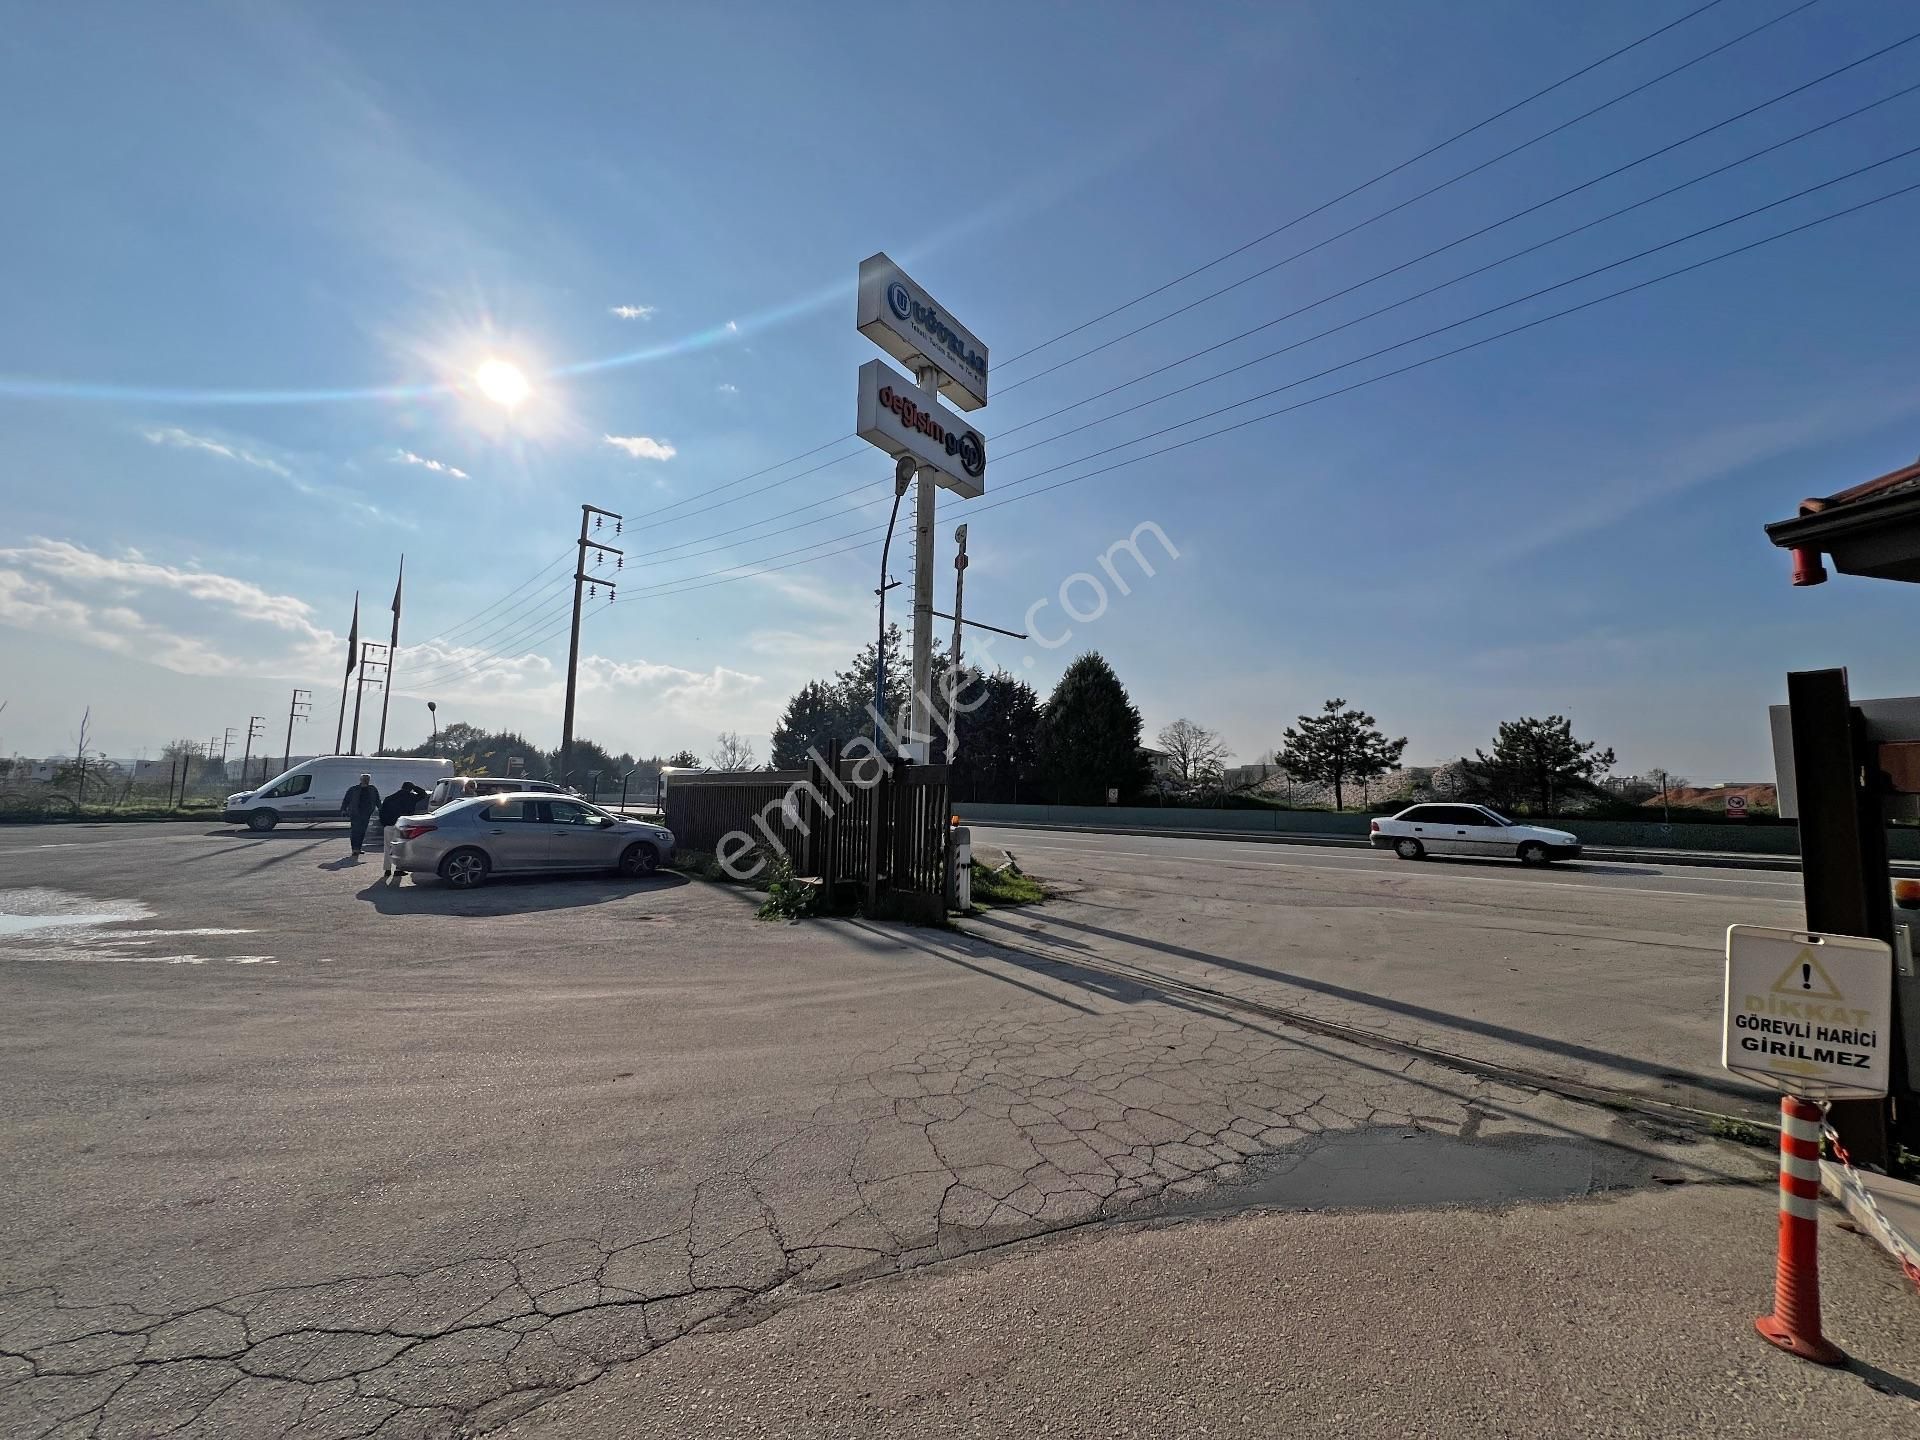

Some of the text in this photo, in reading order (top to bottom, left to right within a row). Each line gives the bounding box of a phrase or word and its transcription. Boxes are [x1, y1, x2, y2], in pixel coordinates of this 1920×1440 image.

[879, 385, 945, 444] değişim
[1745, 993, 1871, 1027] DİKKAT
[1735, 1013, 1877, 1048] GÖREVLİ HARİCİ
[1741, 1036, 1871, 1070] GİRİLMEZ
